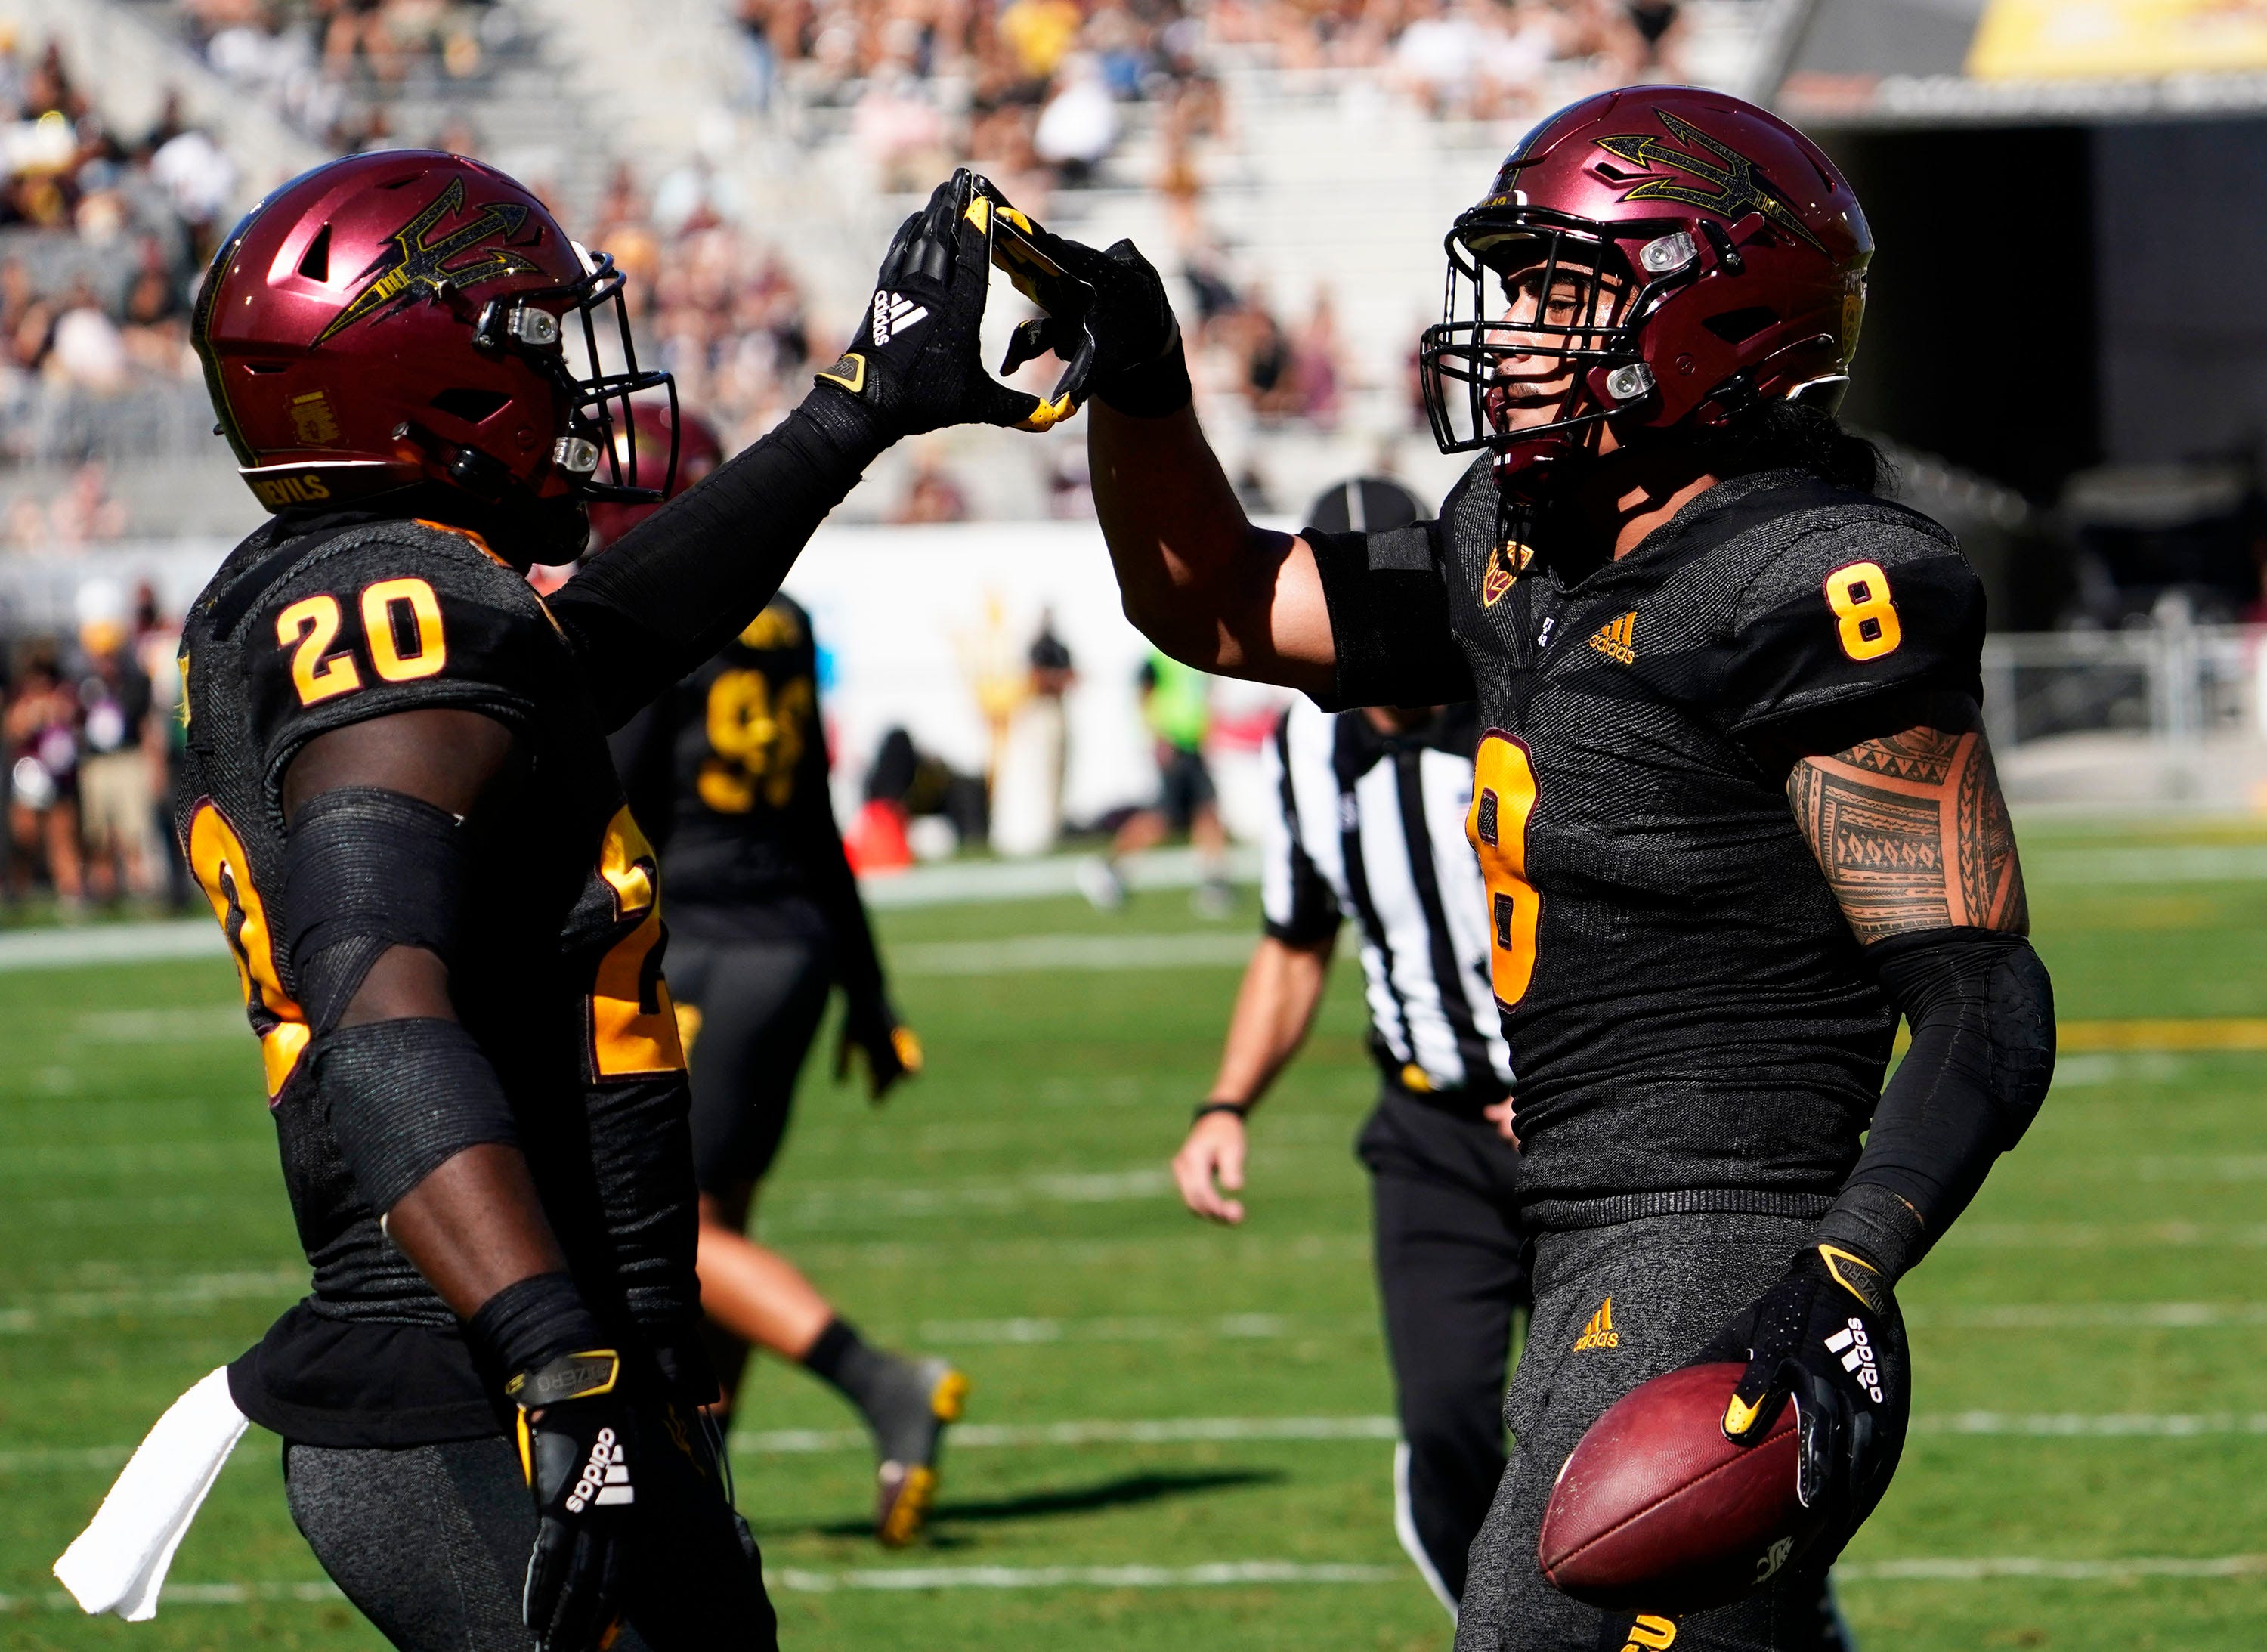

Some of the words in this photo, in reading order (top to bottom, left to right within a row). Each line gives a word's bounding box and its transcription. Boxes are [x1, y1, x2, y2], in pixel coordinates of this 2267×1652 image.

[872, 289, 890, 347] adidas
[276, 577, 447, 708] 20
[1588, 633, 1636, 665] adidas
[1823, 559, 1905, 663] 8
[1464, 726, 1545, 1014] 8
[594, 803, 690, 1084] 2
[1848, 1316, 1884, 1404] adidas
[565, 1426, 616, 1514] adidas
[1620, 1614, 1678, 1652] U
